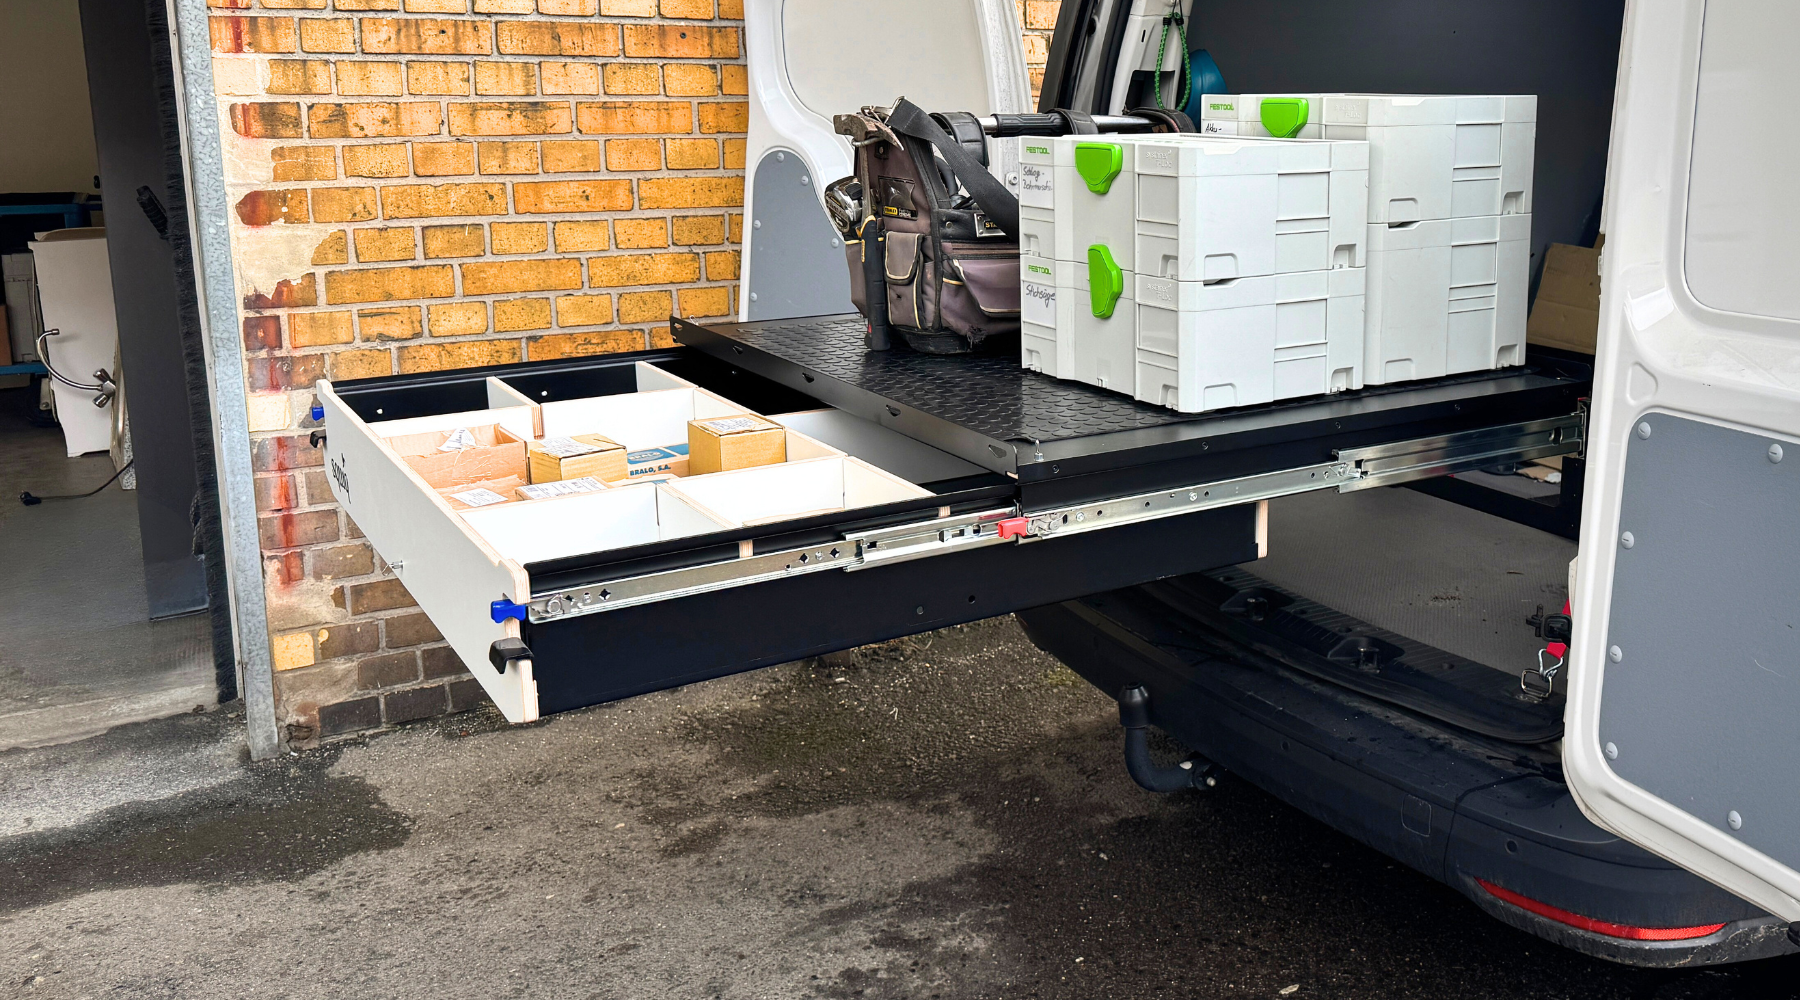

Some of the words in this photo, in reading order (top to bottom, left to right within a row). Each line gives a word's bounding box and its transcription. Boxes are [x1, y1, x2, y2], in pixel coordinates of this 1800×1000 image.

[1209, 103, 1234, 111] FESTOOL
[1026, 146, 1050, 155] FESTOOL
[1028, 264, 1051, 275] FESTOOL
[629, 467, 656, 476] BRALO,
[658, 464, 672, 472] S.A.
